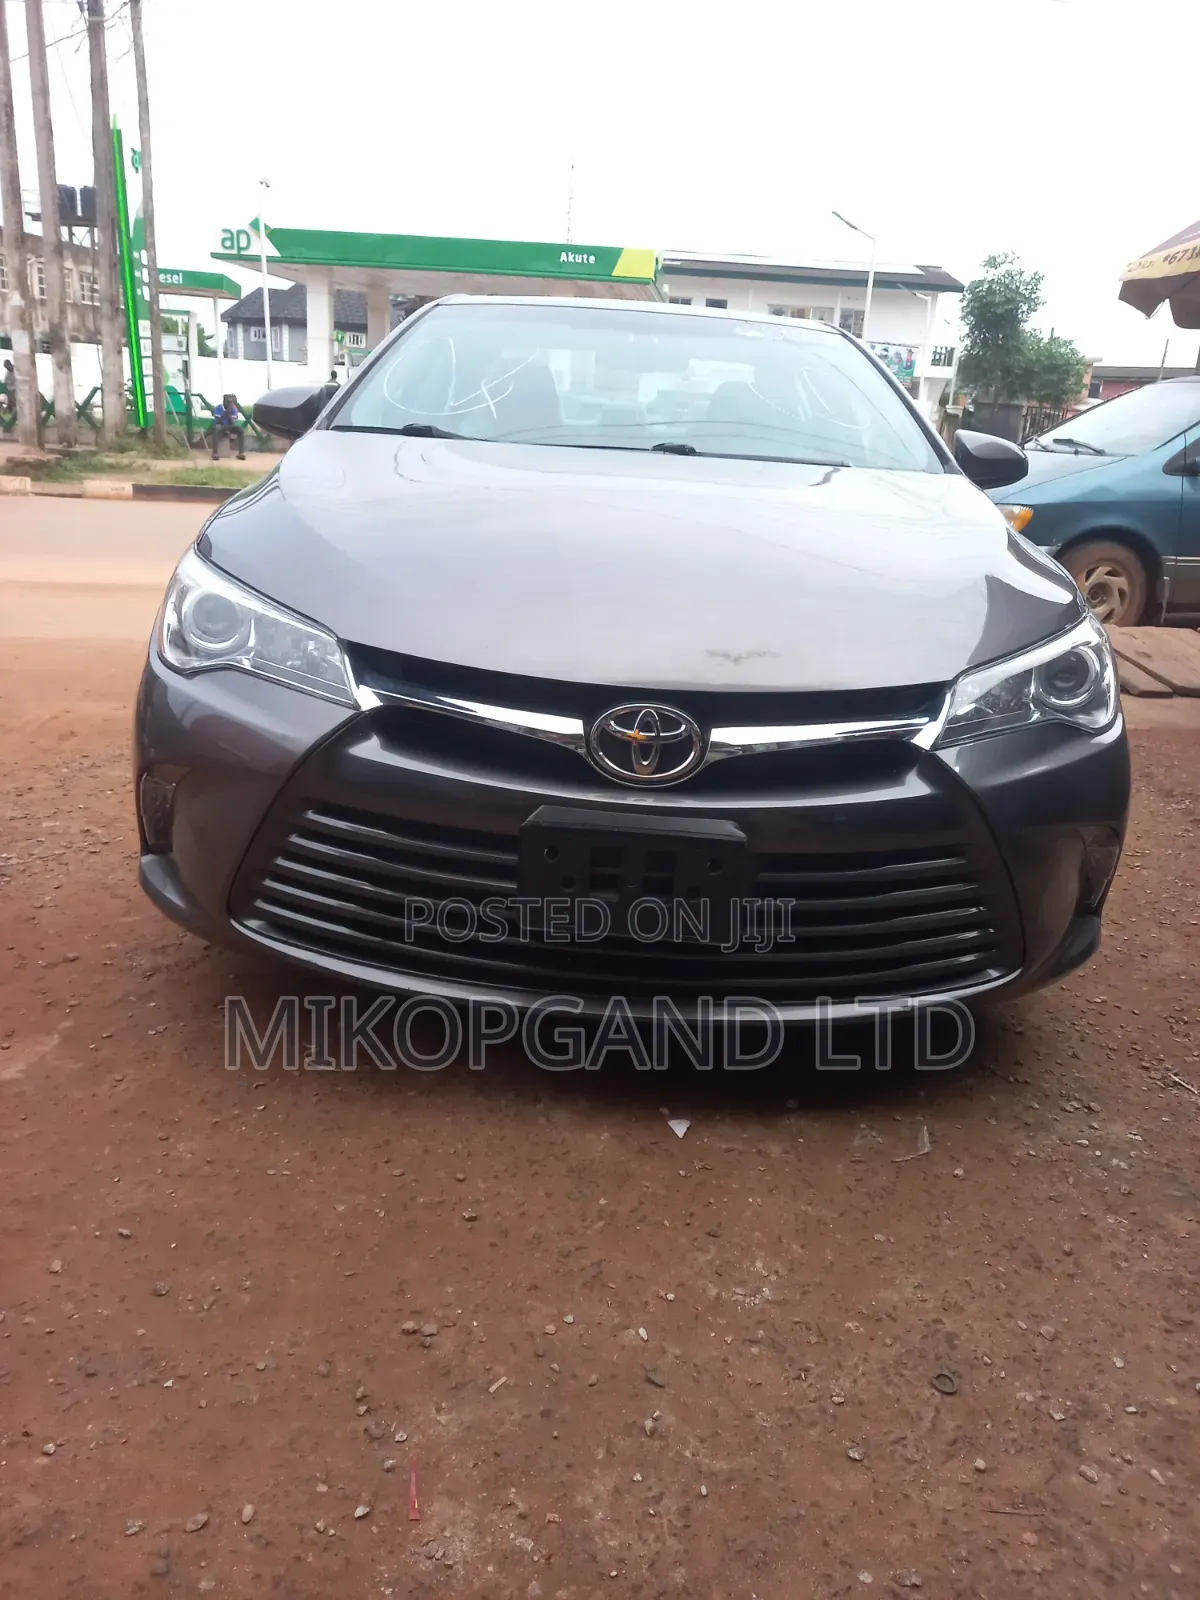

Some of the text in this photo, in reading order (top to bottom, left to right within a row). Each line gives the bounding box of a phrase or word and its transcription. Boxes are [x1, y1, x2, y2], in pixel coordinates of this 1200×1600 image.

[221, 228, 251, 259] ap
[560, 251, 596, 264] Akute
[158, 272, 183, 285] esel
